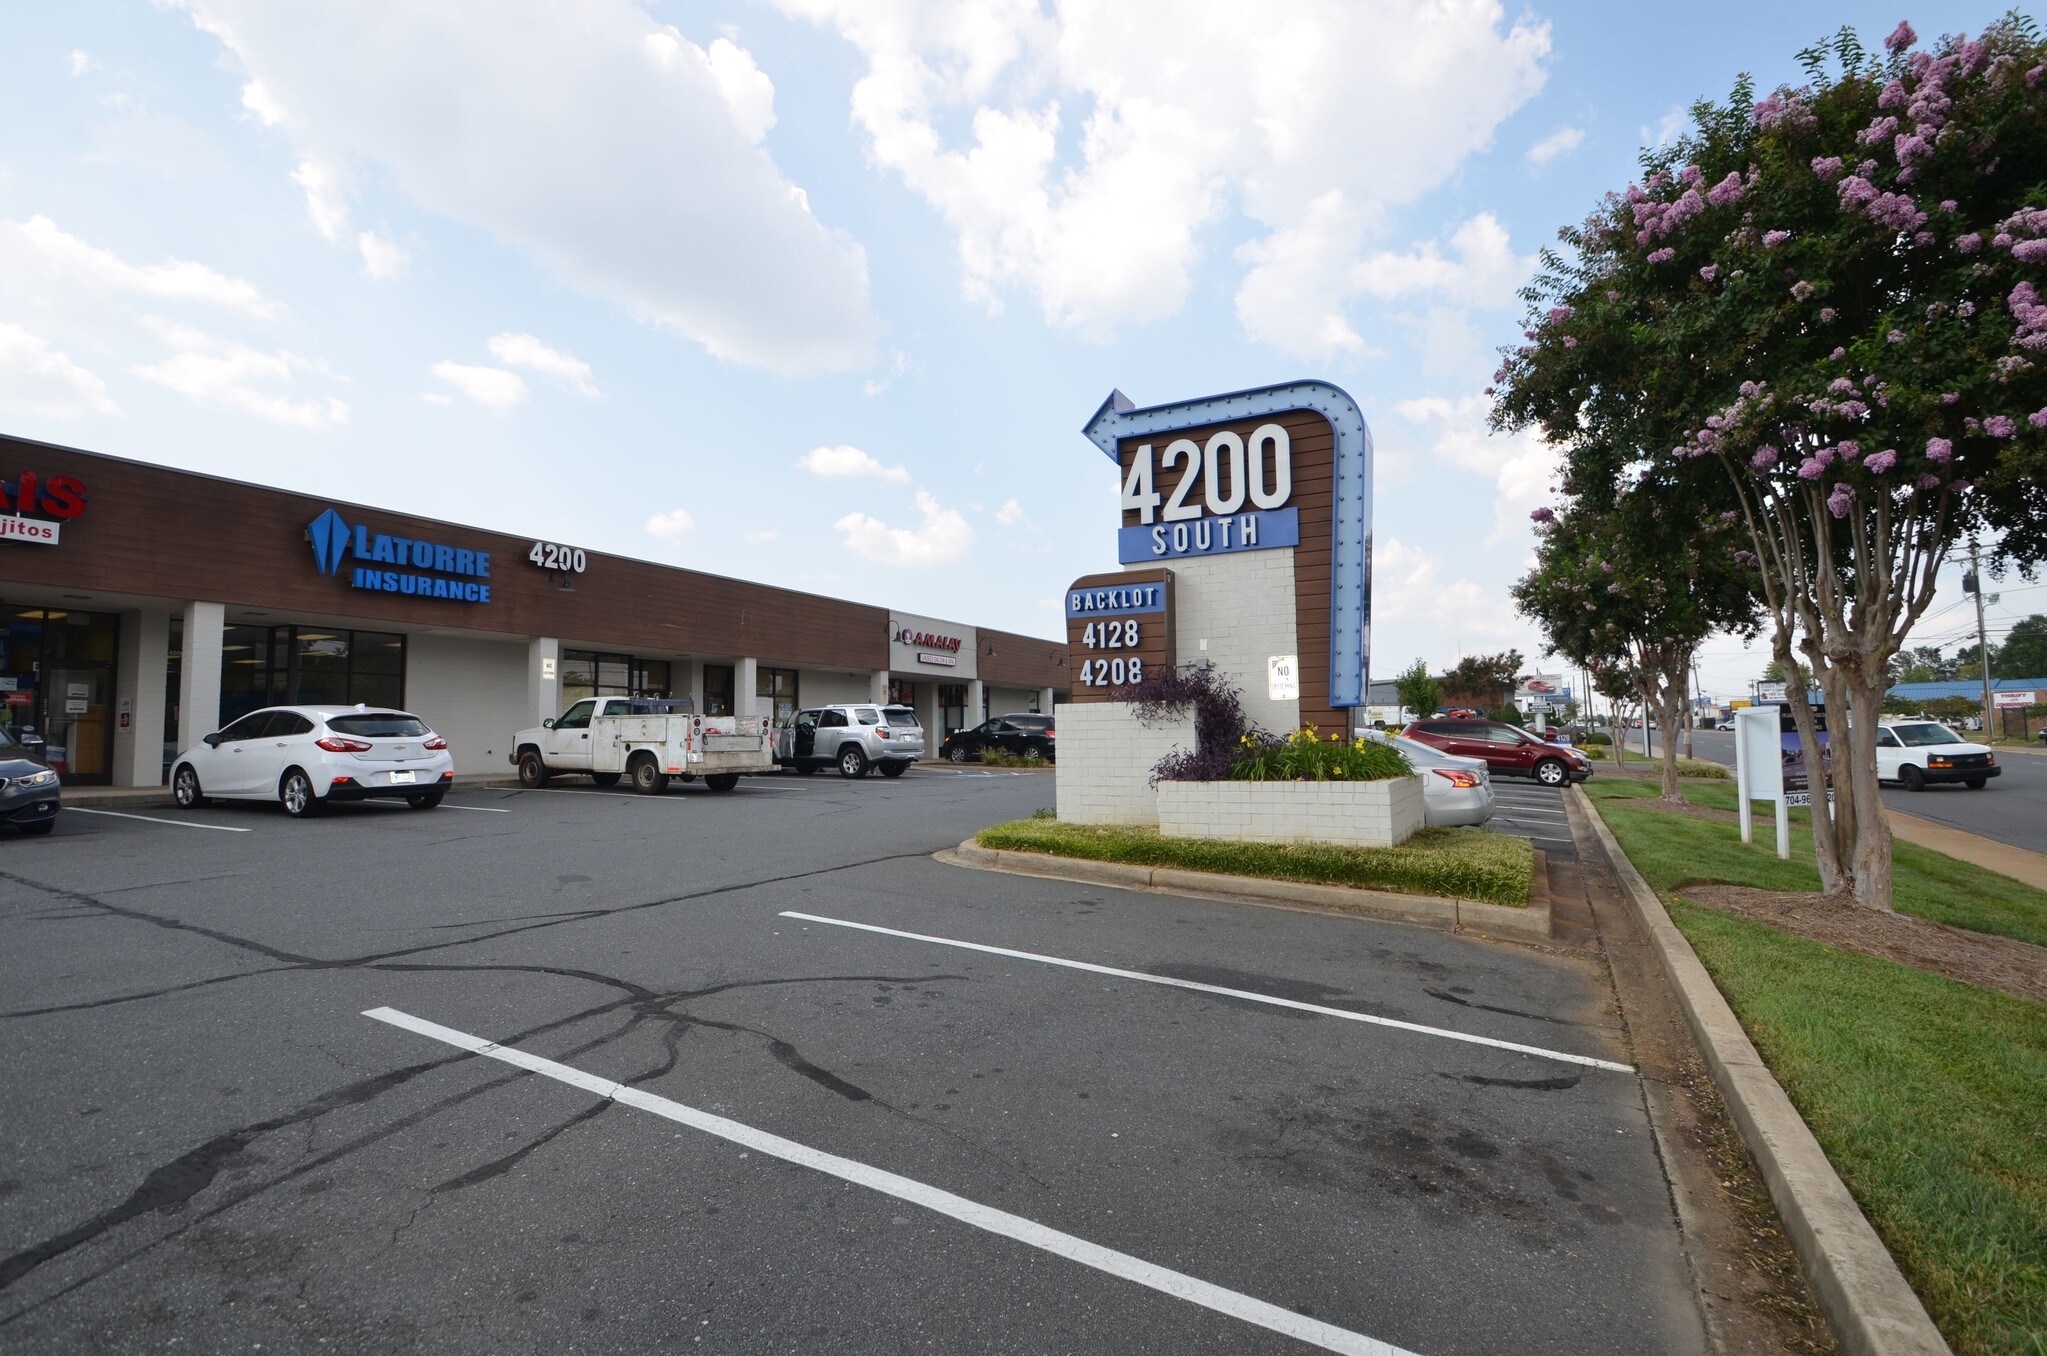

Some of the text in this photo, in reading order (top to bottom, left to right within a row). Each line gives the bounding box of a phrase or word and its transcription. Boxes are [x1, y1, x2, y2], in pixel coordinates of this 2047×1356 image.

[1121, 423, 1291, 524] 4200
[1151, 515, 1257, 555] SOUTH
[529, 542, 586, 574] 4200
[352, 568, 490, 603] INSURANCE
[1071, 587, 1156, 612] BACKLOT
[1082, 619, 1139, 649] 4128
[1080, 657, 1142, 687] 4208
[1277, 666, 1290, 676] NO
